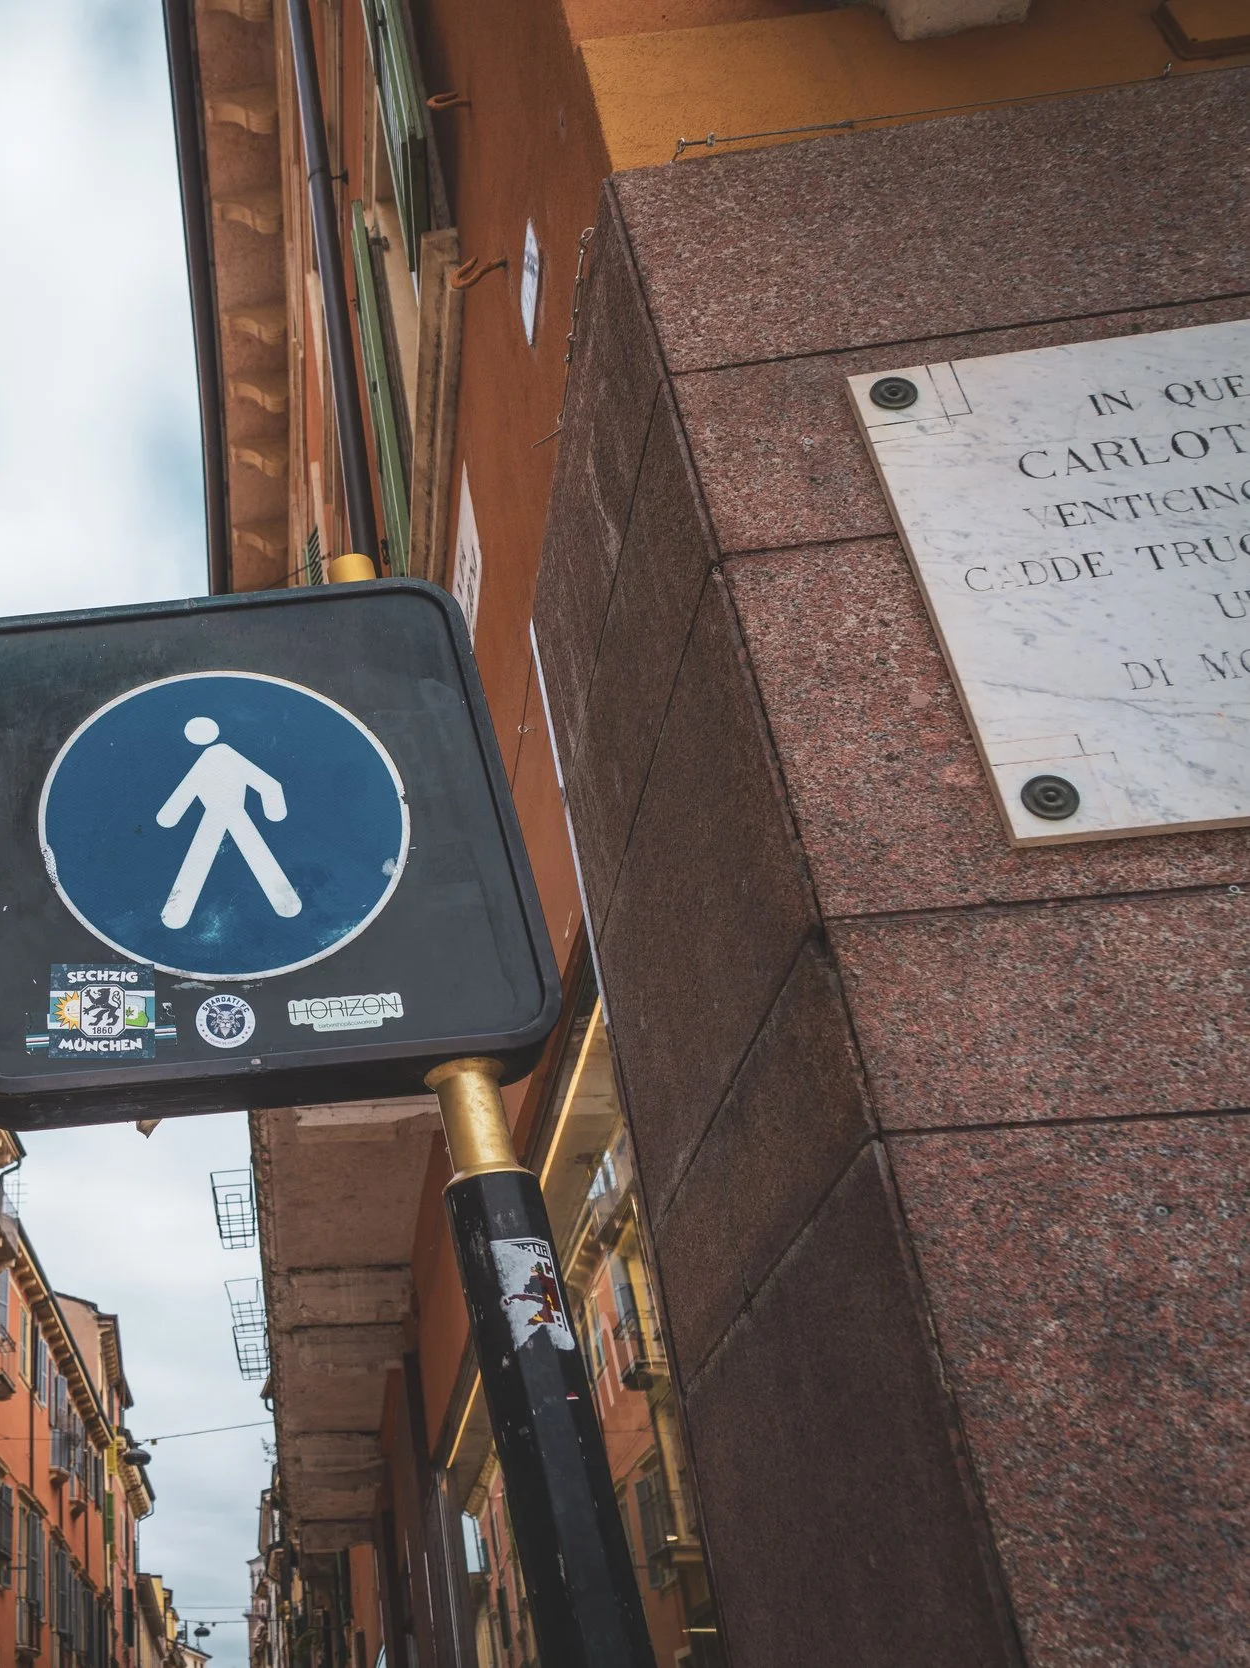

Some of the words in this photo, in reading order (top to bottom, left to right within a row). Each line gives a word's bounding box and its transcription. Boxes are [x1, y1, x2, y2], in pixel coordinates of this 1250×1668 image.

[1088, 388, 1135, 417] IN
[1121, 659, 1175, 691] DI
[66, 970, 139, 983] SECHZIG
[291, 995, 399, 1021] HORIZON
[92, 1026, 113, 1035] 1860
[58, 1037, 143, 1052] MÜNCHEN
